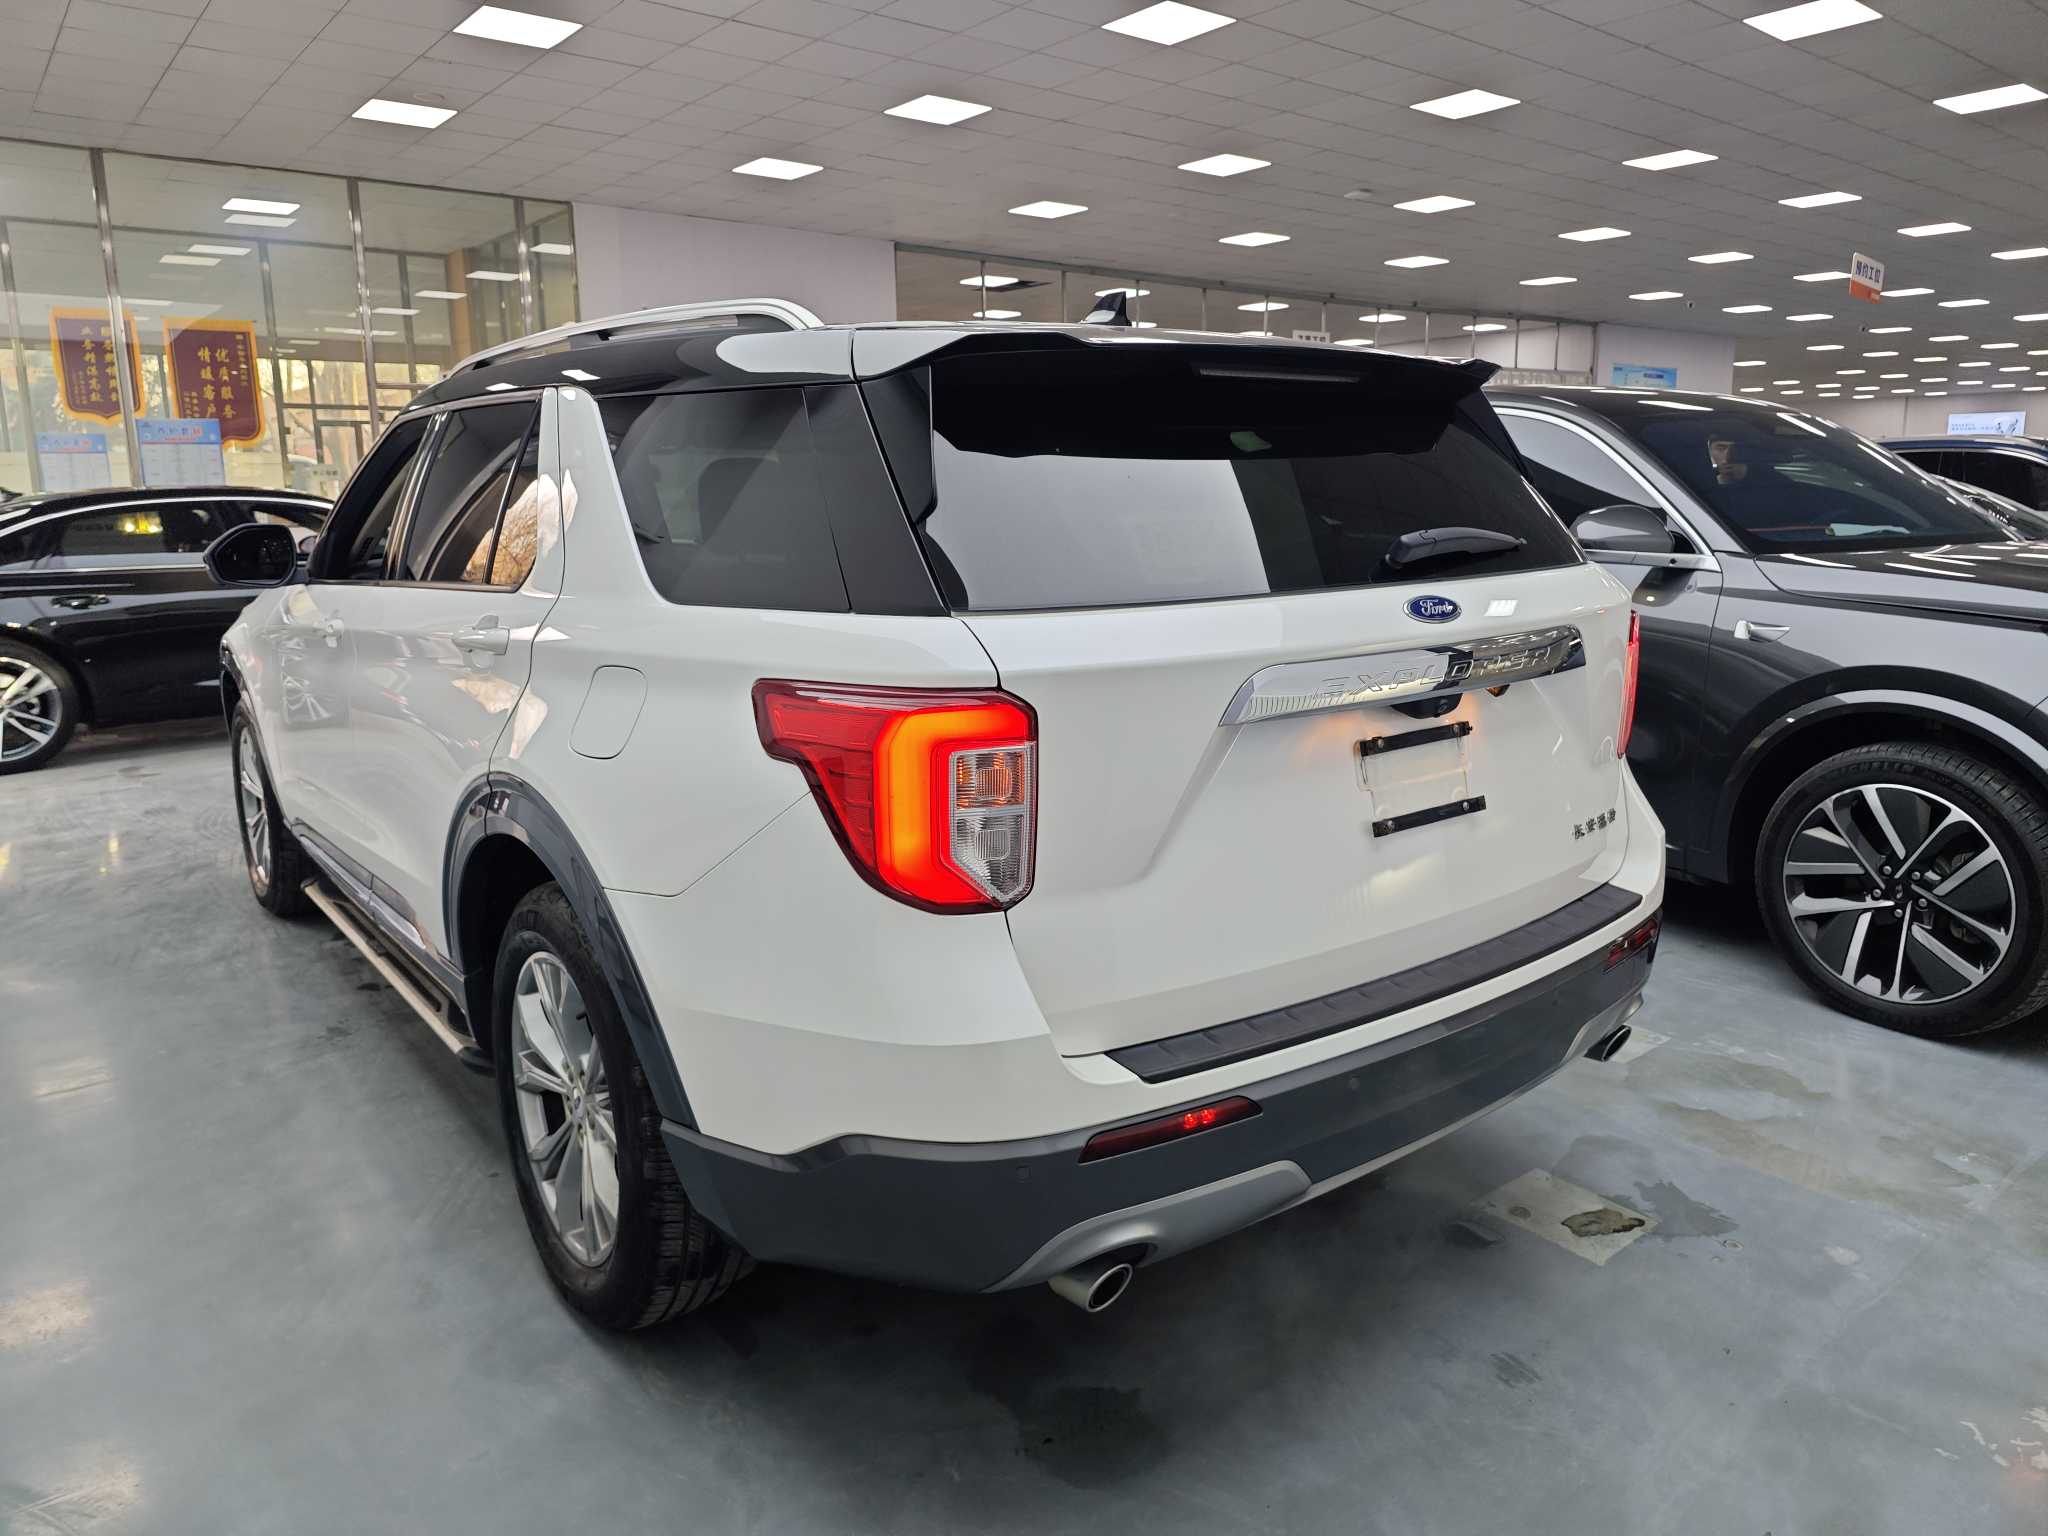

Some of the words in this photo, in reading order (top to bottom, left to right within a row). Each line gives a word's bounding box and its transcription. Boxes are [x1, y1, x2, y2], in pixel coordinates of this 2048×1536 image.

[215, 347, 237, 418] 优质服务
[1573, 808, 1616, 840] 长安福特
